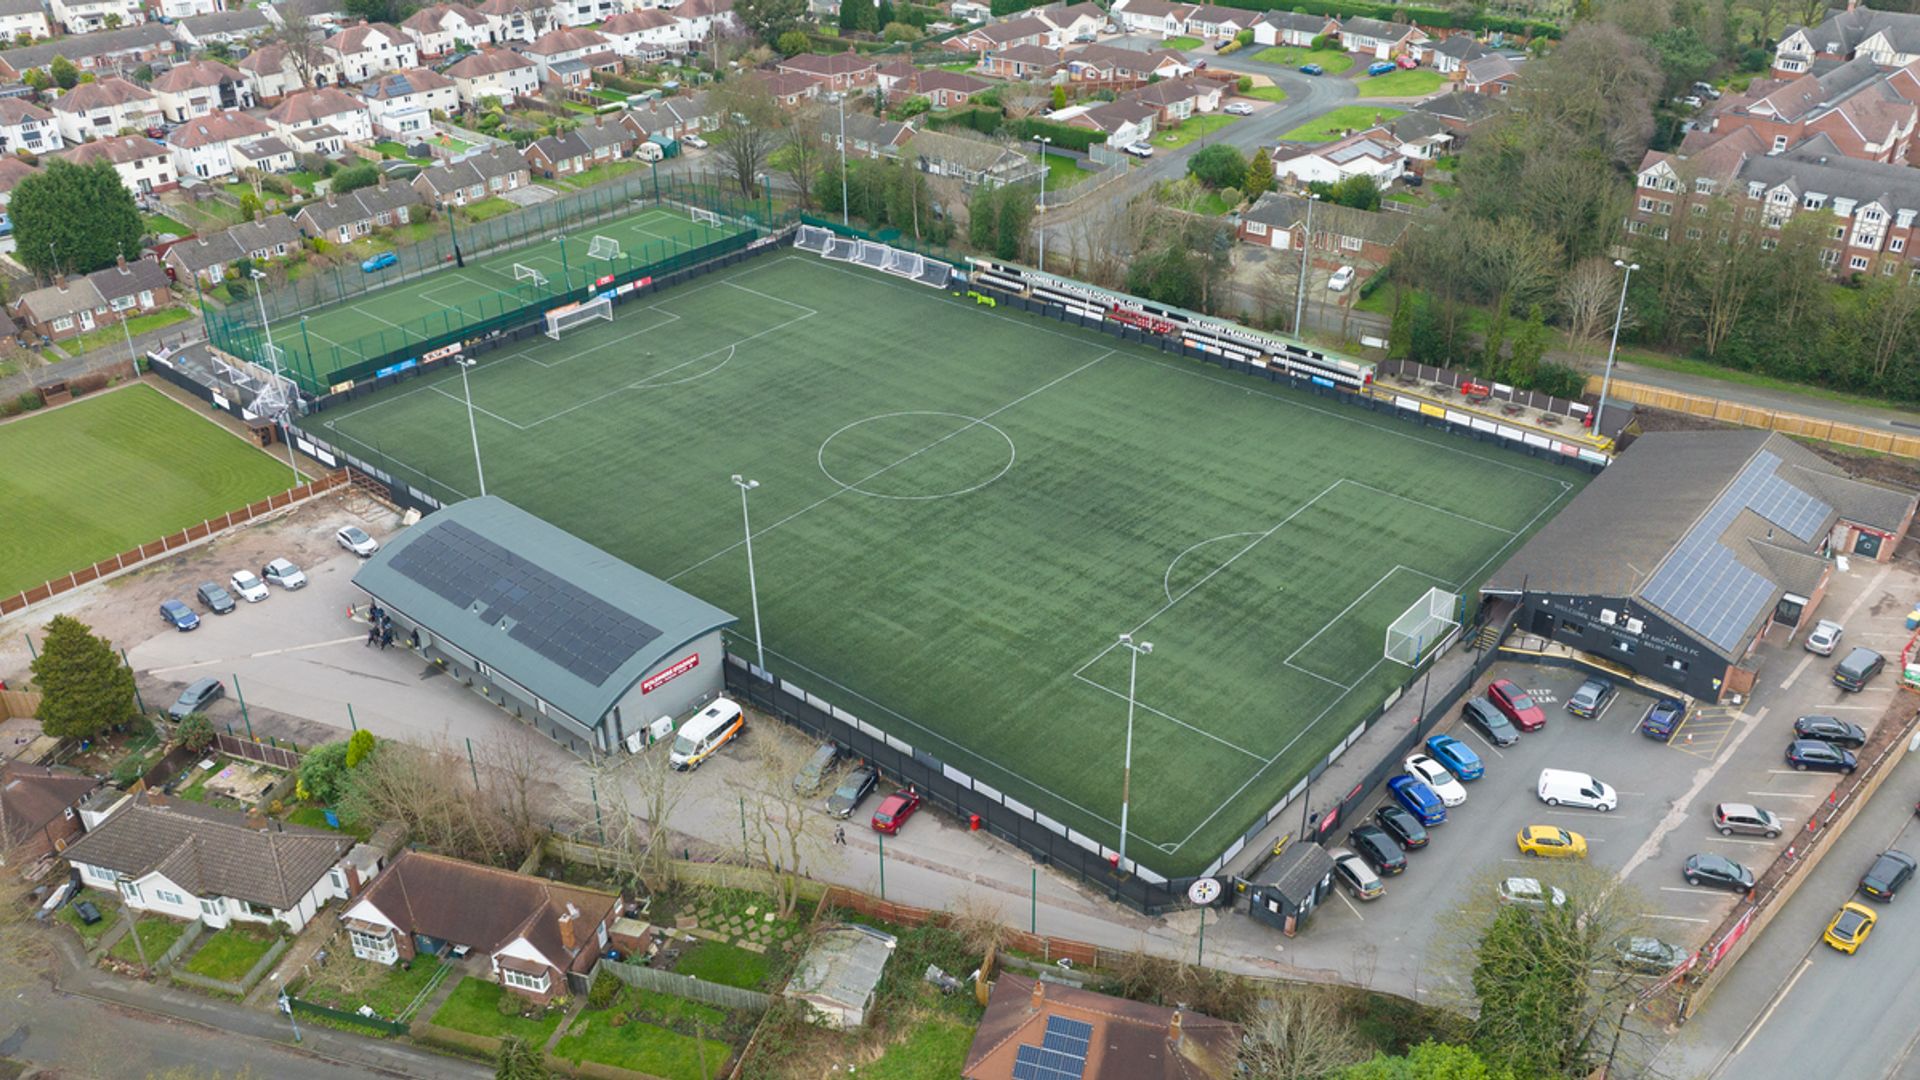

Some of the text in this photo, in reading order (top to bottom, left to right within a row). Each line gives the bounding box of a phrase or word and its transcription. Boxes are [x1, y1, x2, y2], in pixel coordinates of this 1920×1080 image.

[1554, 603, 1588, 619] WELCOME
[1650, 635, 1688, 653] MICHAELS
[1689, 649, 1699, 657] FC
[1643, 641, 1665, 652] BELIEF
